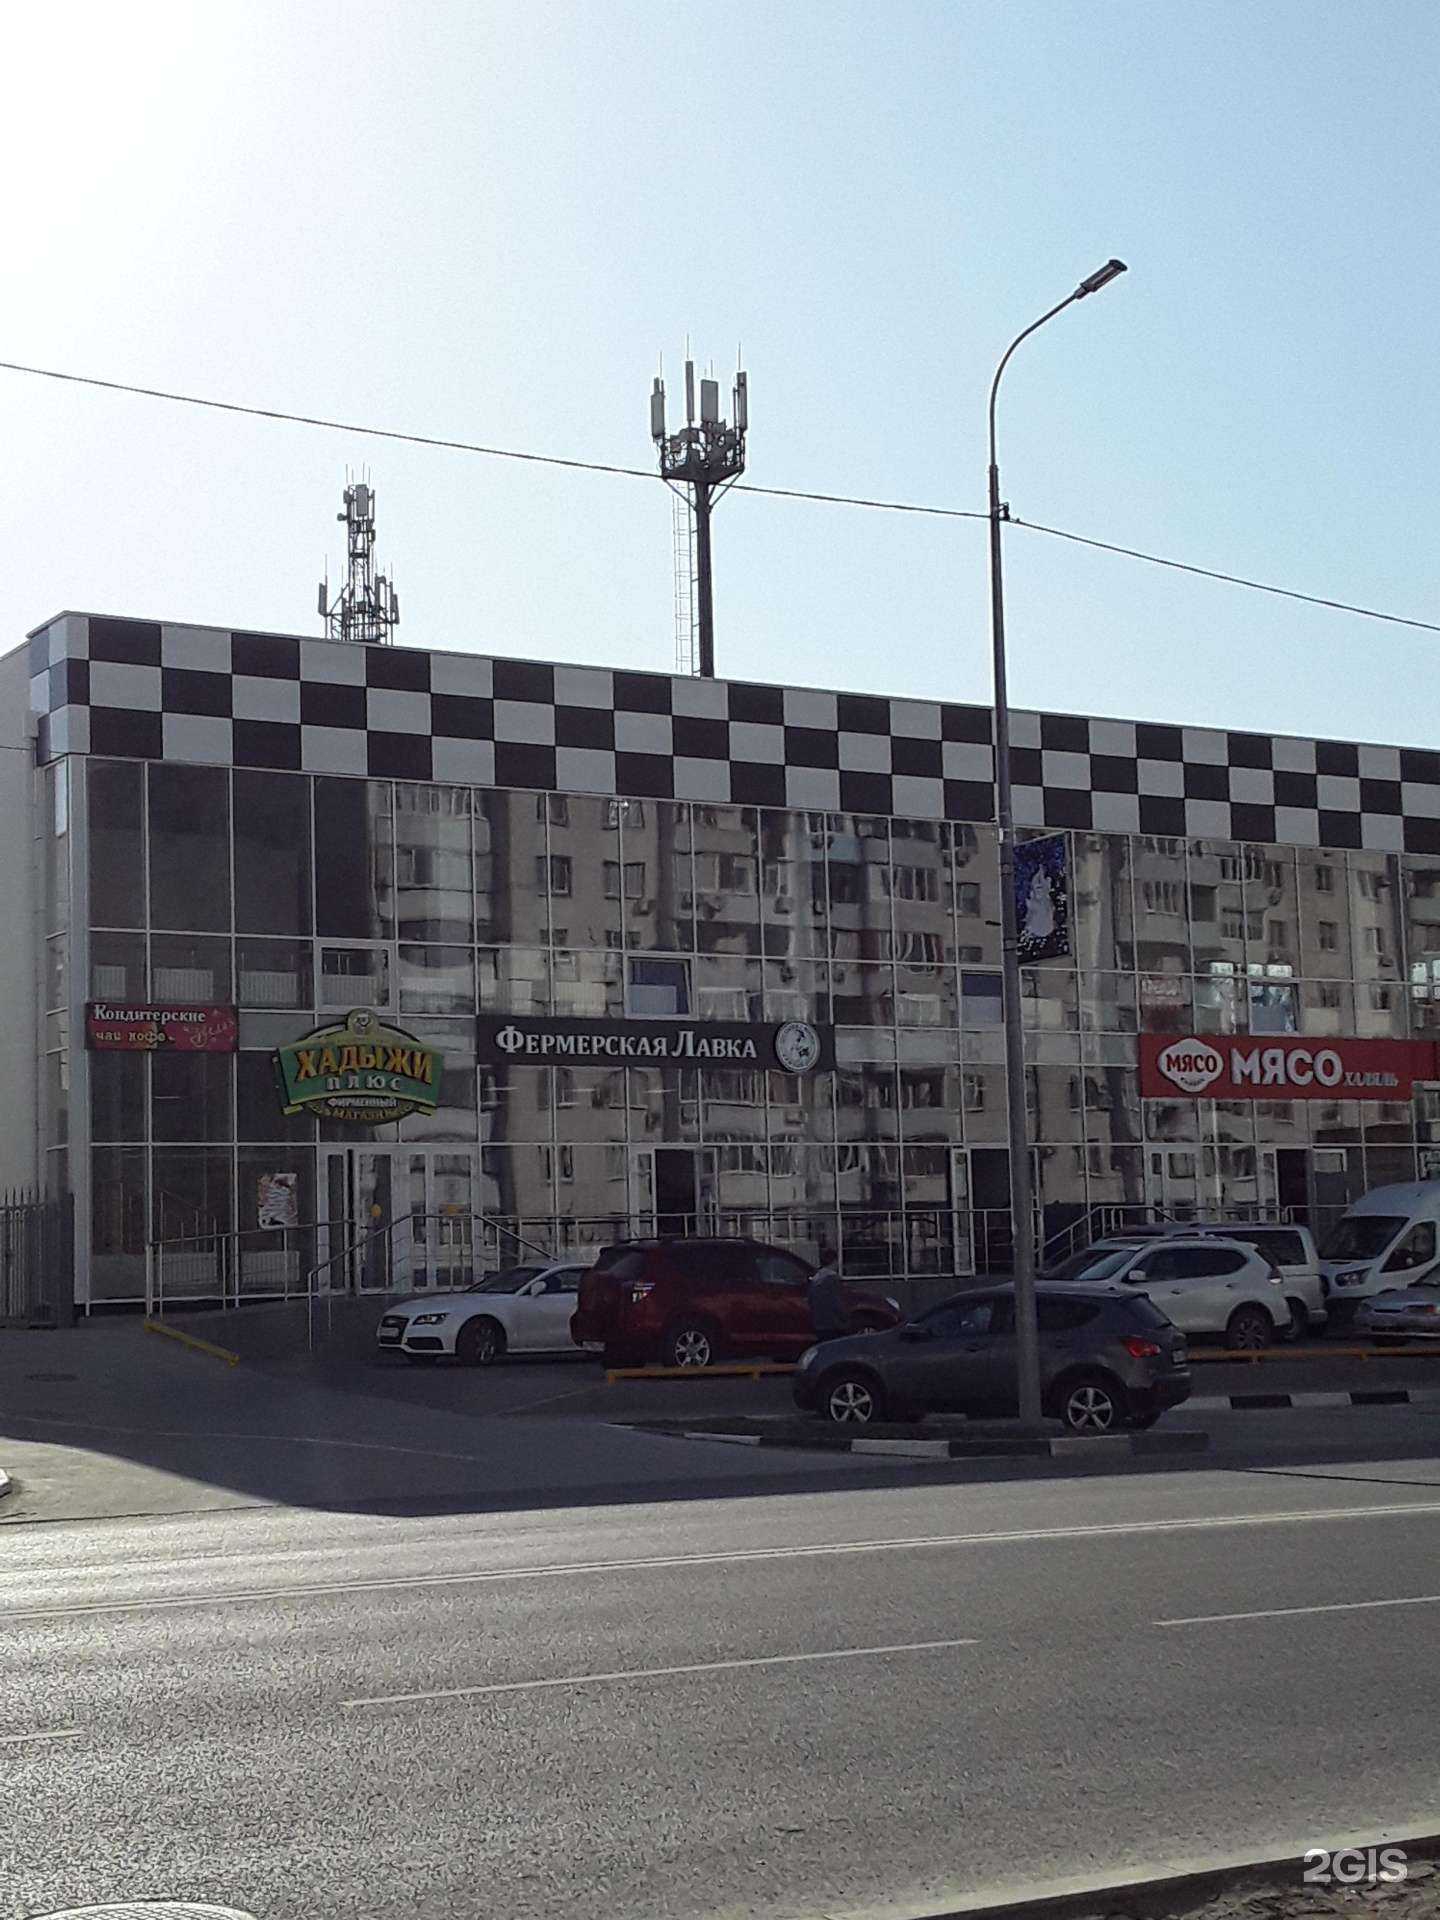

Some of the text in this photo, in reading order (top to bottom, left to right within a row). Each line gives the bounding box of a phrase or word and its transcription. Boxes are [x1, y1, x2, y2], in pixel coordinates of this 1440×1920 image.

[95, 1004, 206, 1024] Кондитерские
[495, 1026, 757, 1058] ФЕРМЕРСКАЯ ЛАВКА
[296, 1046, 432, 1084] ХАДЫЖИ
[1166, 1054, 1217, 1073] МЯСО
[1230, 1049, 1343, 1086] МЯСО
